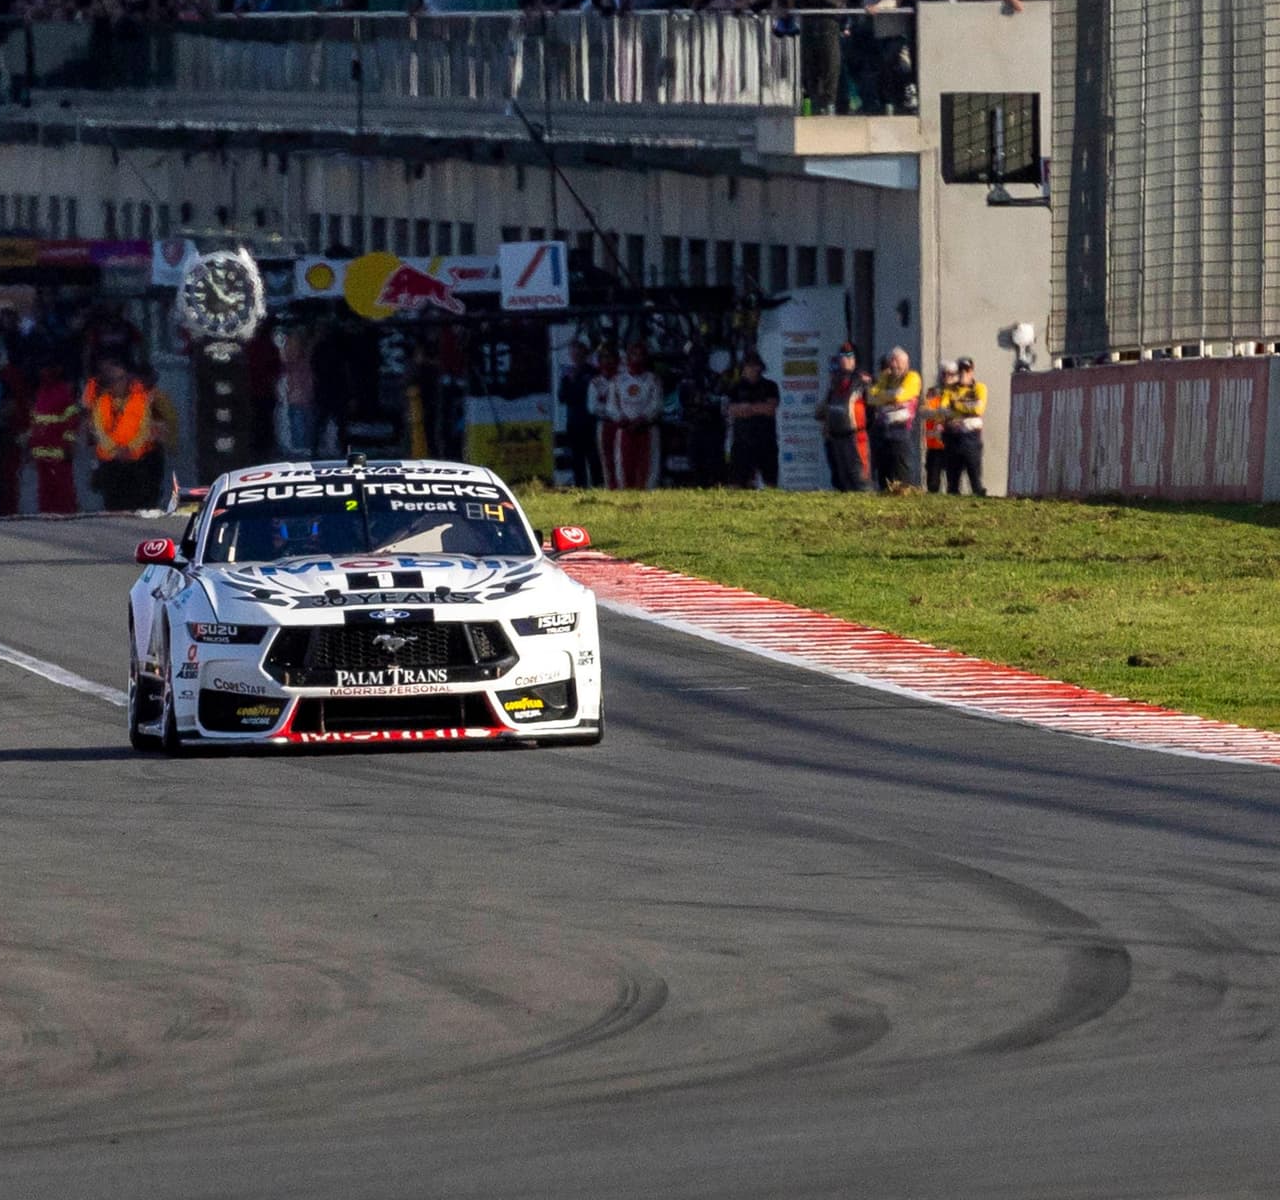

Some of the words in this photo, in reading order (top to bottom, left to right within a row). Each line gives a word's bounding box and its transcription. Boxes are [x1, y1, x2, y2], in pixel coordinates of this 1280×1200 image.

[225, 483, 353, 505] ISUZU
[363, 483, 500, 499] TRUCKS
[344, 500, 358, 512] 2
[389, 499, 458, 512] Percat
[196, 623, 238, 636] ISUZU
[336, 669, 384, 687] PALM
[387, 665, 448, 687] TRANS
